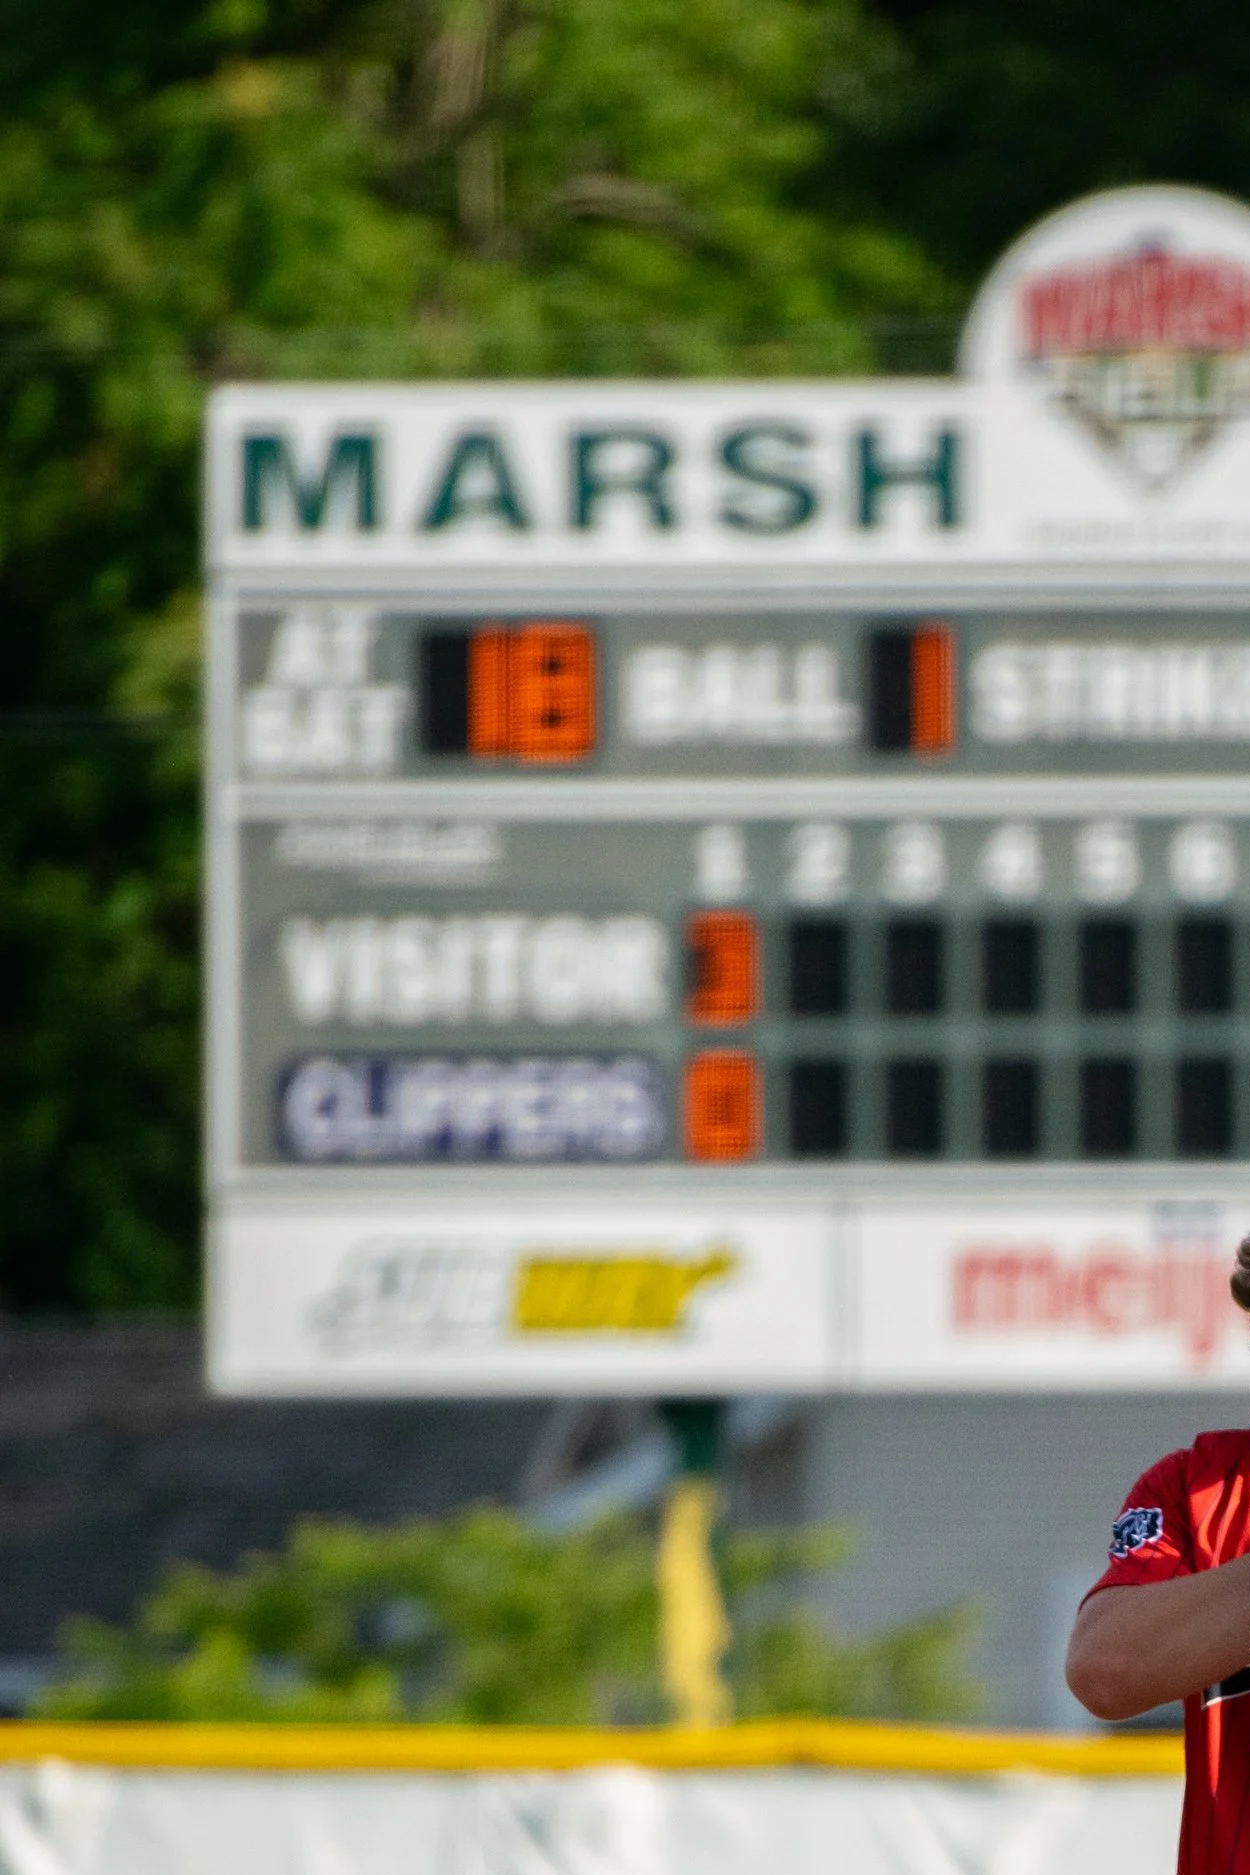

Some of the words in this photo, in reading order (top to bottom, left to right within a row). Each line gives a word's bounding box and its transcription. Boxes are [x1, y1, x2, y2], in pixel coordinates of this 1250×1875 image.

[239, 418, 964, 534] MARSH
[626, 645, 858, 747] BALL
[785, 820, 850, 899] 2
[883, 820, 947, 899] 3
[982, 820, 1043, 899] 4
[281, 911, 667, 1024] VISITOR
[283, 1056, 667, 1158] CLIPPERS
